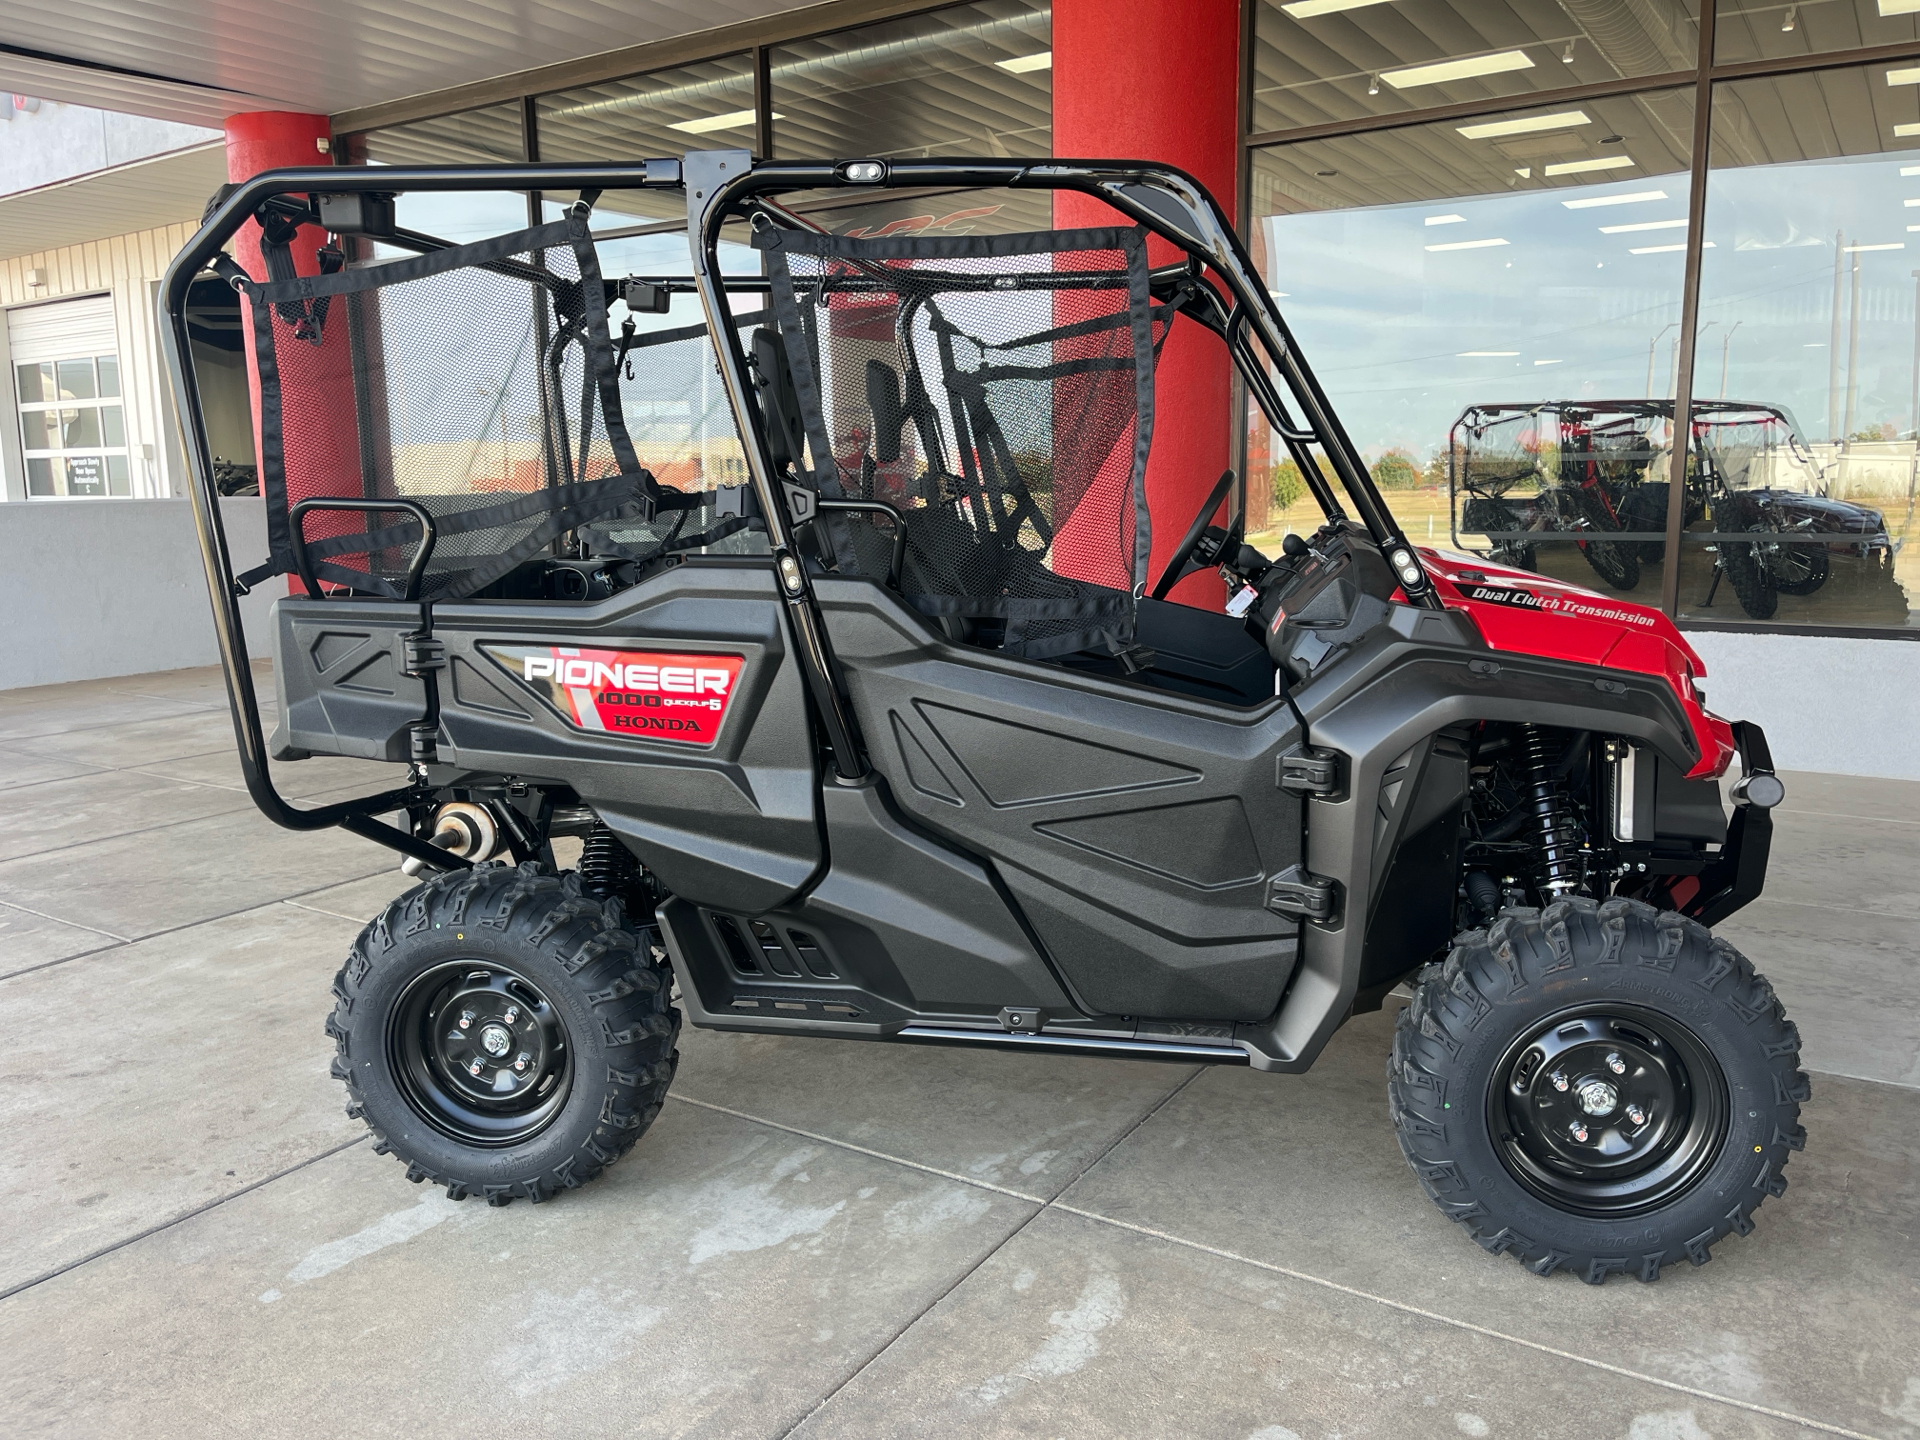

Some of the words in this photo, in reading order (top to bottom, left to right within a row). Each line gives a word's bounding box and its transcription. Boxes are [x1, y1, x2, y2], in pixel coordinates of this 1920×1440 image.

[74, 476, 99, 485] Automatically
[1471, 587, 1511, 602] Dual
[1511, 592, 1560, 609] Clutch
[1562, 600, 1655, 627] Transmission
[524, 656, 730, 695] PIONEER
[598, 691, 661, 708] 1000
[613, 714, 702, 732] HONDA
[1606, 977, 1692, 1010] ARMSTRONG
